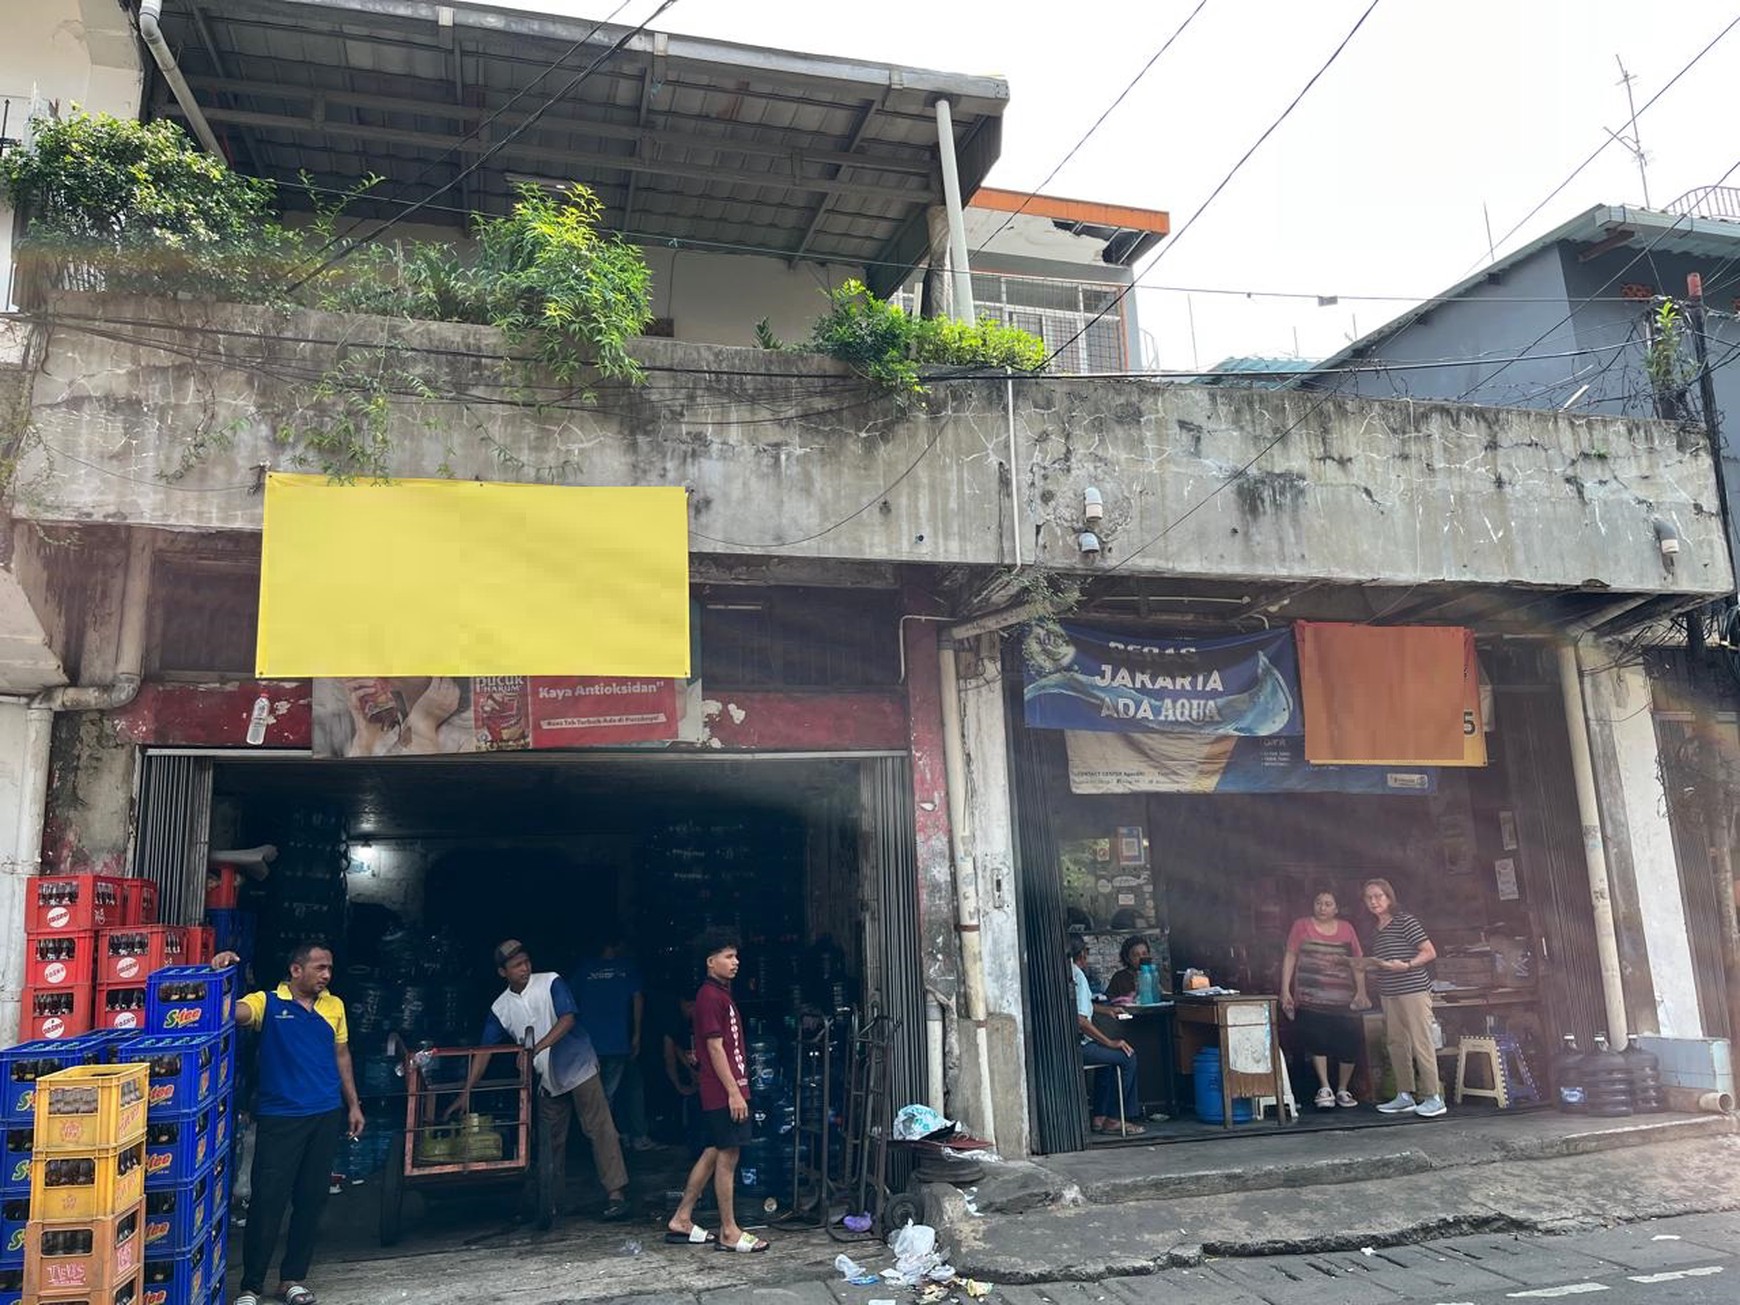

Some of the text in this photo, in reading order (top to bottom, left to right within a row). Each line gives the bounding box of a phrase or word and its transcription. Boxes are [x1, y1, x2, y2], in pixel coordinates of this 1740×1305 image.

[1096, 664, 1224, 692] JAKARTA
[538, 686, 572, 700] Kaya
[1100, 697, 1223, 725] ADA AQUA
[149, 1085, 175, 1106] tee
